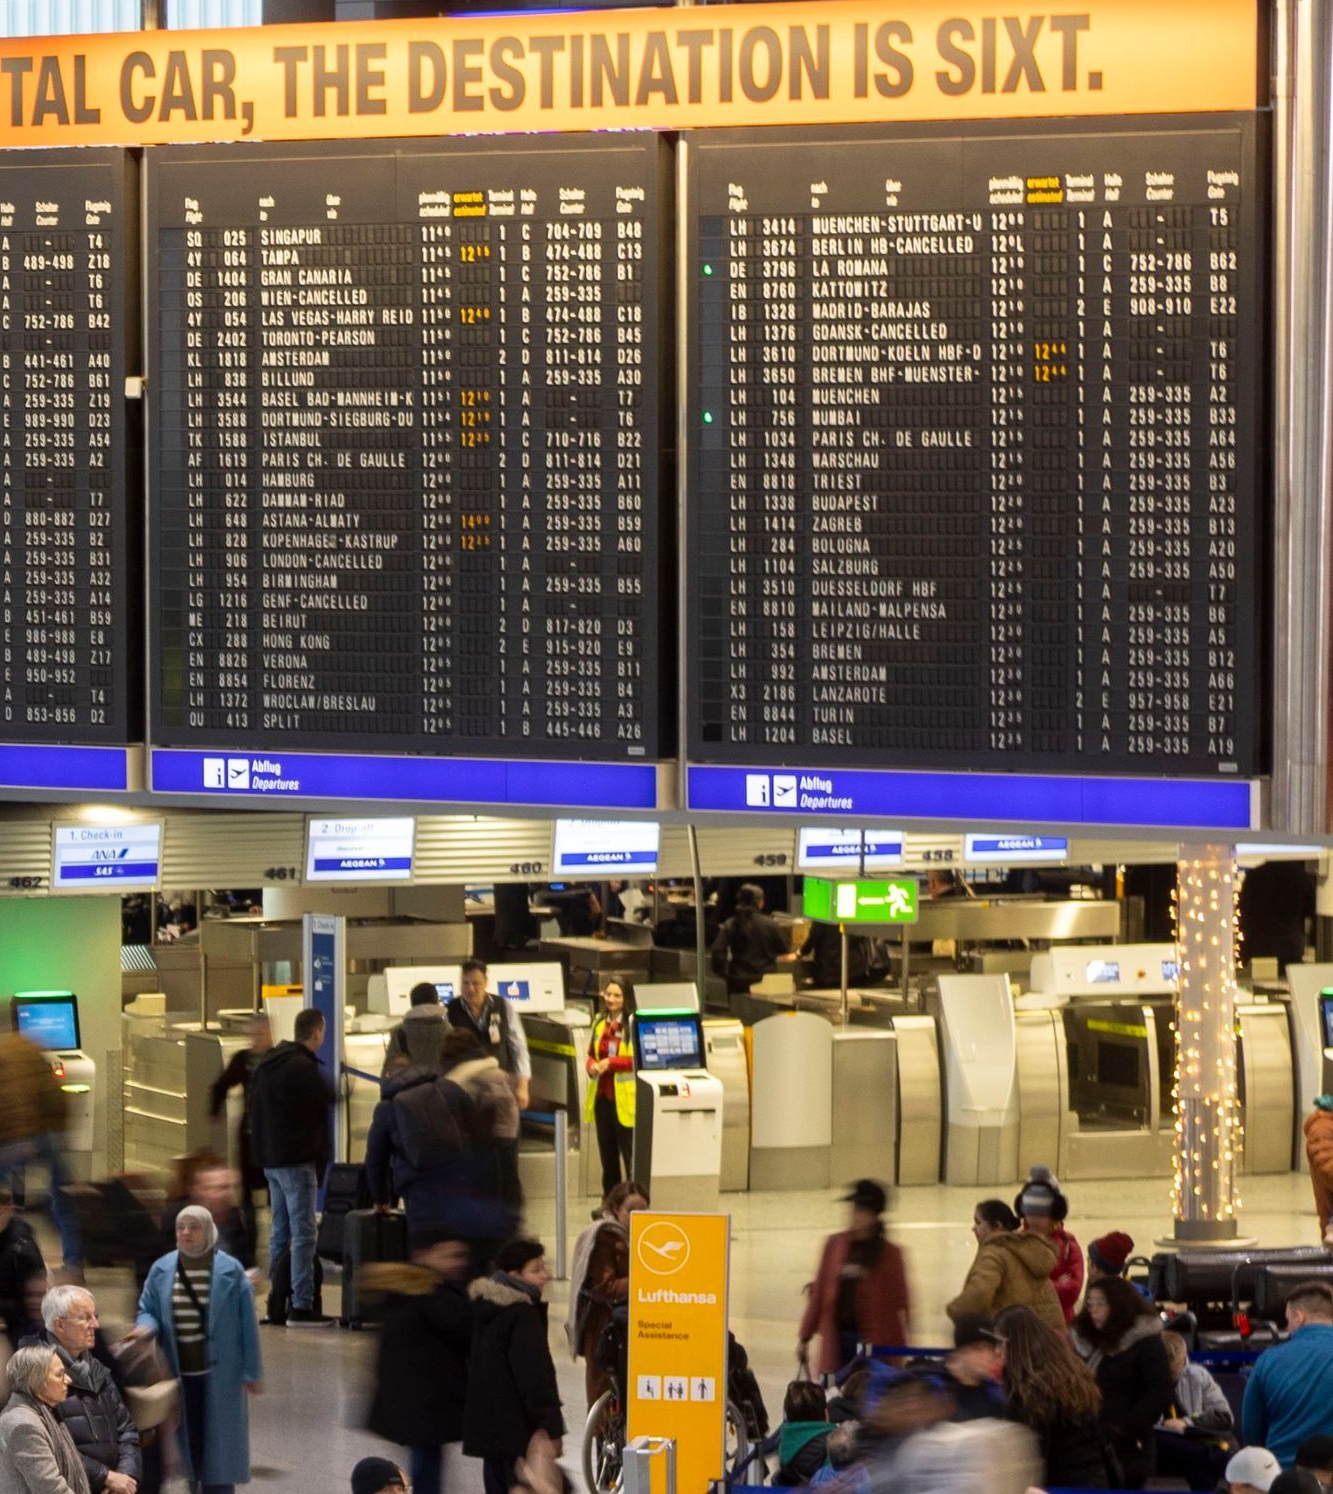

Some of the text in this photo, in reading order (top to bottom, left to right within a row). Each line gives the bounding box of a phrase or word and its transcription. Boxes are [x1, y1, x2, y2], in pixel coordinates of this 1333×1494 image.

[119, 49, 256, 133] CAR,
[274, 42, 387, 119] THE
[407, 24, 832, 114] DESTINATION
[853, 20, 915, 99] IS
[934, 13, 1104, 97] SIXT.
[261, 223, 641, 246] SINGAPUR 704-709 B48
[24, 255, 75, 270] 489-498
[88, 255, 110, 269] Z18
[813, 259, 888, 276] LA ROMANA
[187, 269, 352, 287] DE 1404 GRAN CANARIA
[813, 281, 888, 298] KATTOWITZ
[24, 315, 75, 329] 752-786
[88, 314, 110, 328] B42
[262, 330, 375, 346] TORONTO-PEARSON
[262, 350, 330, 366] AMSTERDAM
[813, 409, 861, 426] MUMBAI
[263, 432, 602, 448] ISTANBUL 710-716
[813, 495, 878, 512] BUDAPEST
[812, 559, 879, 576] SALZBURG
[263, 573, 338, 589] BIRMINGHAM
[812, 622, 921, 641] LEIPZIG/HALLE
[263, 634, 330, 650] HONG KONG
[812, 686, 887, 704] LANZAROTE
[263, 695, 376, 712] WROCLAW/BRESLAU
[252, 760, 281, 776] Abflug
[252, 777, 299, 792] Departures
[800, 777, 832, 794] Abflug
[800, 793, 853, 809] Departures
[81, 829, 123, 840] Check-in
[997, 841, 1033, 849] AEGEAN
[92, 850, 117, 859] ANA
[587, 853, 623, 862] AEGEAN
[341, 859, 377, 868] AEGEAN
[10, 877, 42, 889] 462
[638, 1288, 716, 1304] Lufthansa
[638, 1320, 672, 1330] Special
[638, 1331, 689, 1340] Assistance
